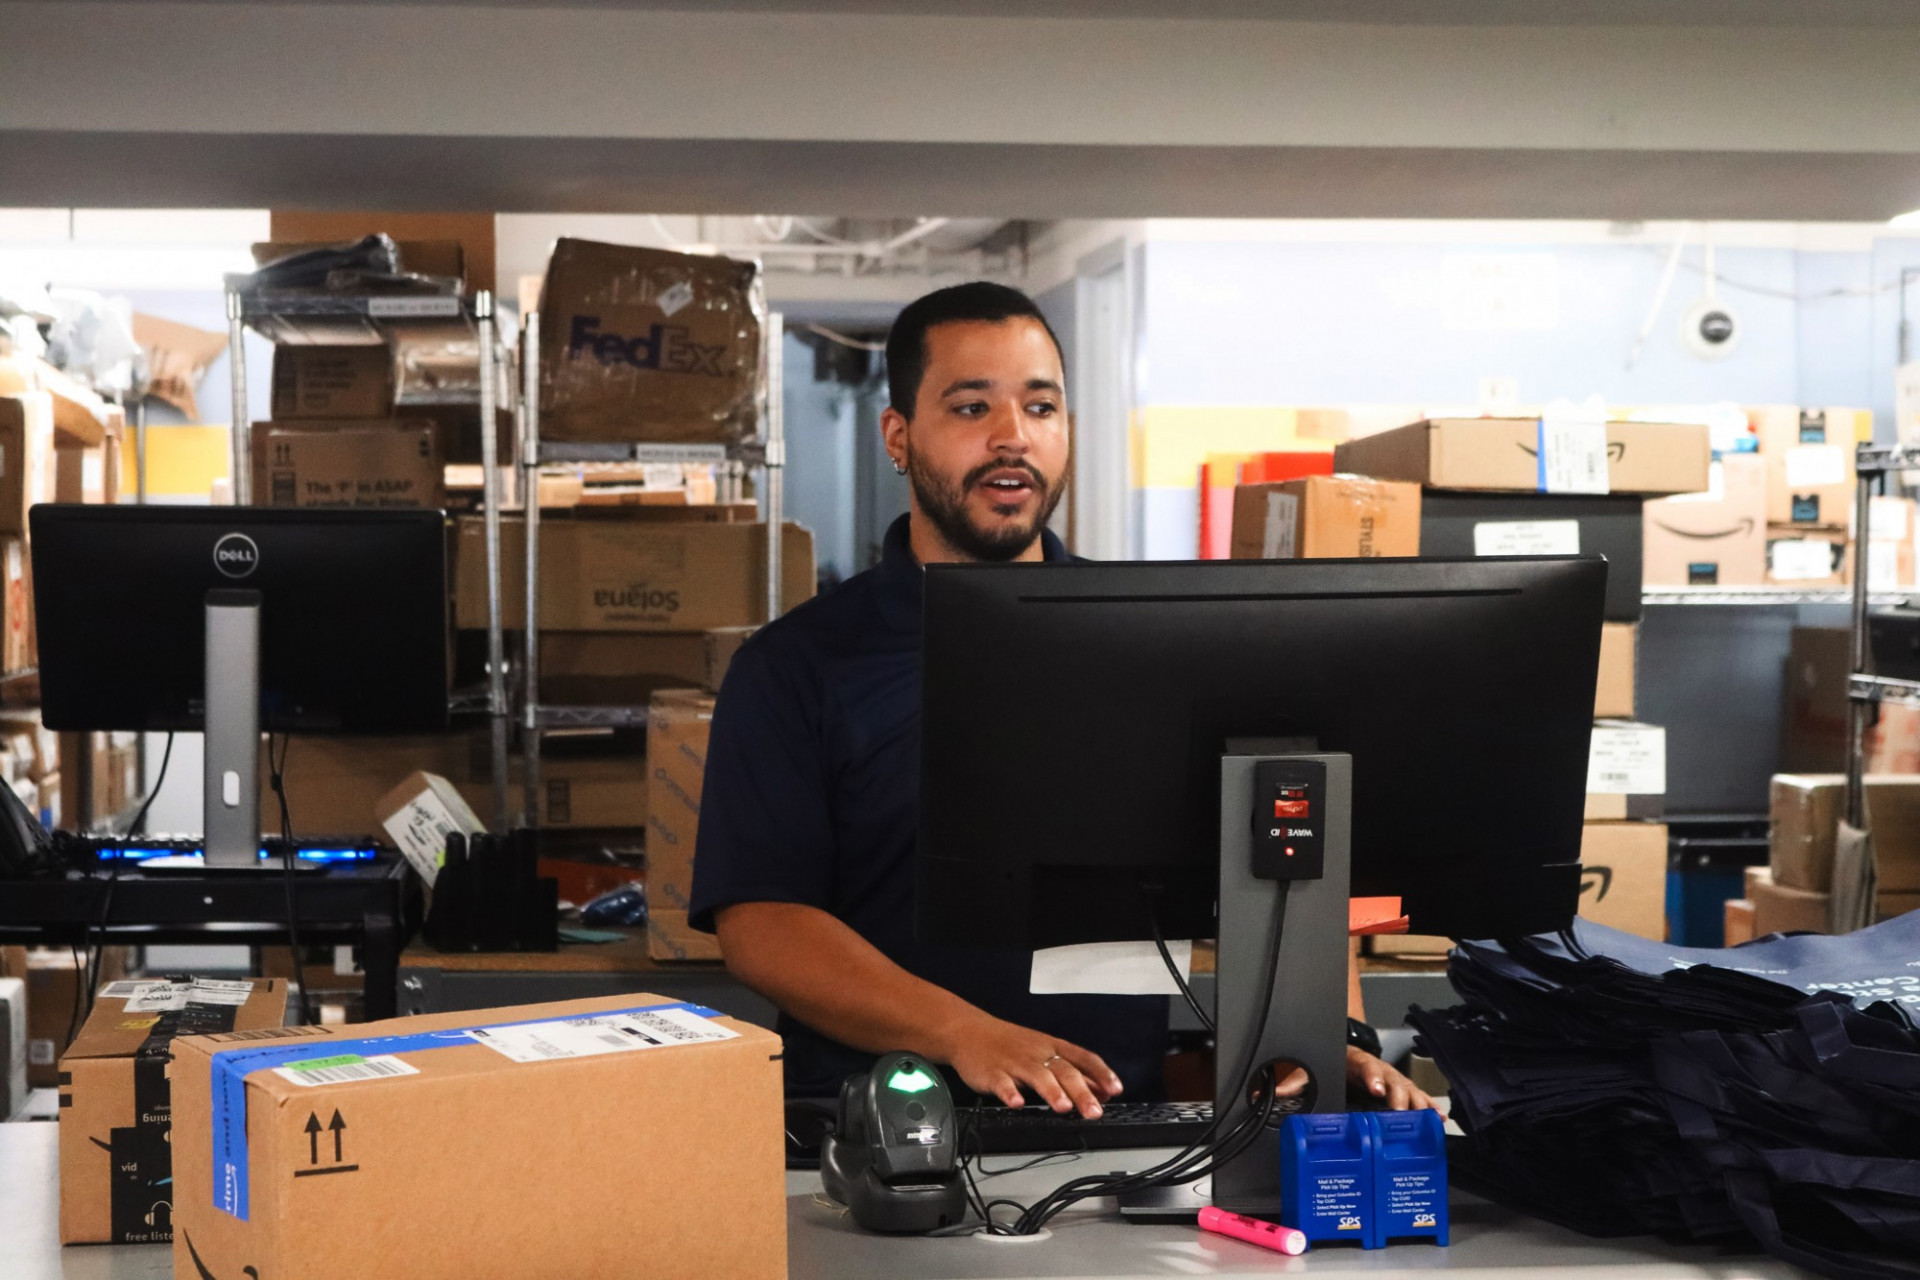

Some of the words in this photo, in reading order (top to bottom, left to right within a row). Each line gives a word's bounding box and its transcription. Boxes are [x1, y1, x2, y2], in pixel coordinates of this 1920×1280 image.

[569, 315, 728, 377] FedEx
[306, 481, 331, 494] The
[375, 479, 413, 493] ASAP
[219, 550, 254, 562] DELL
[594, 590, 680, 612] Solana
[1270, 828, 1281, 837] ID
[1287, 828, 1313, 837] WAVE
[121, 1162, 138, 1172] vid
[1340, 1216, 1362, 1227] SPS
[1415, 1213, 1437, 1224] SPS
[125, 1232, 148, 1242] free
